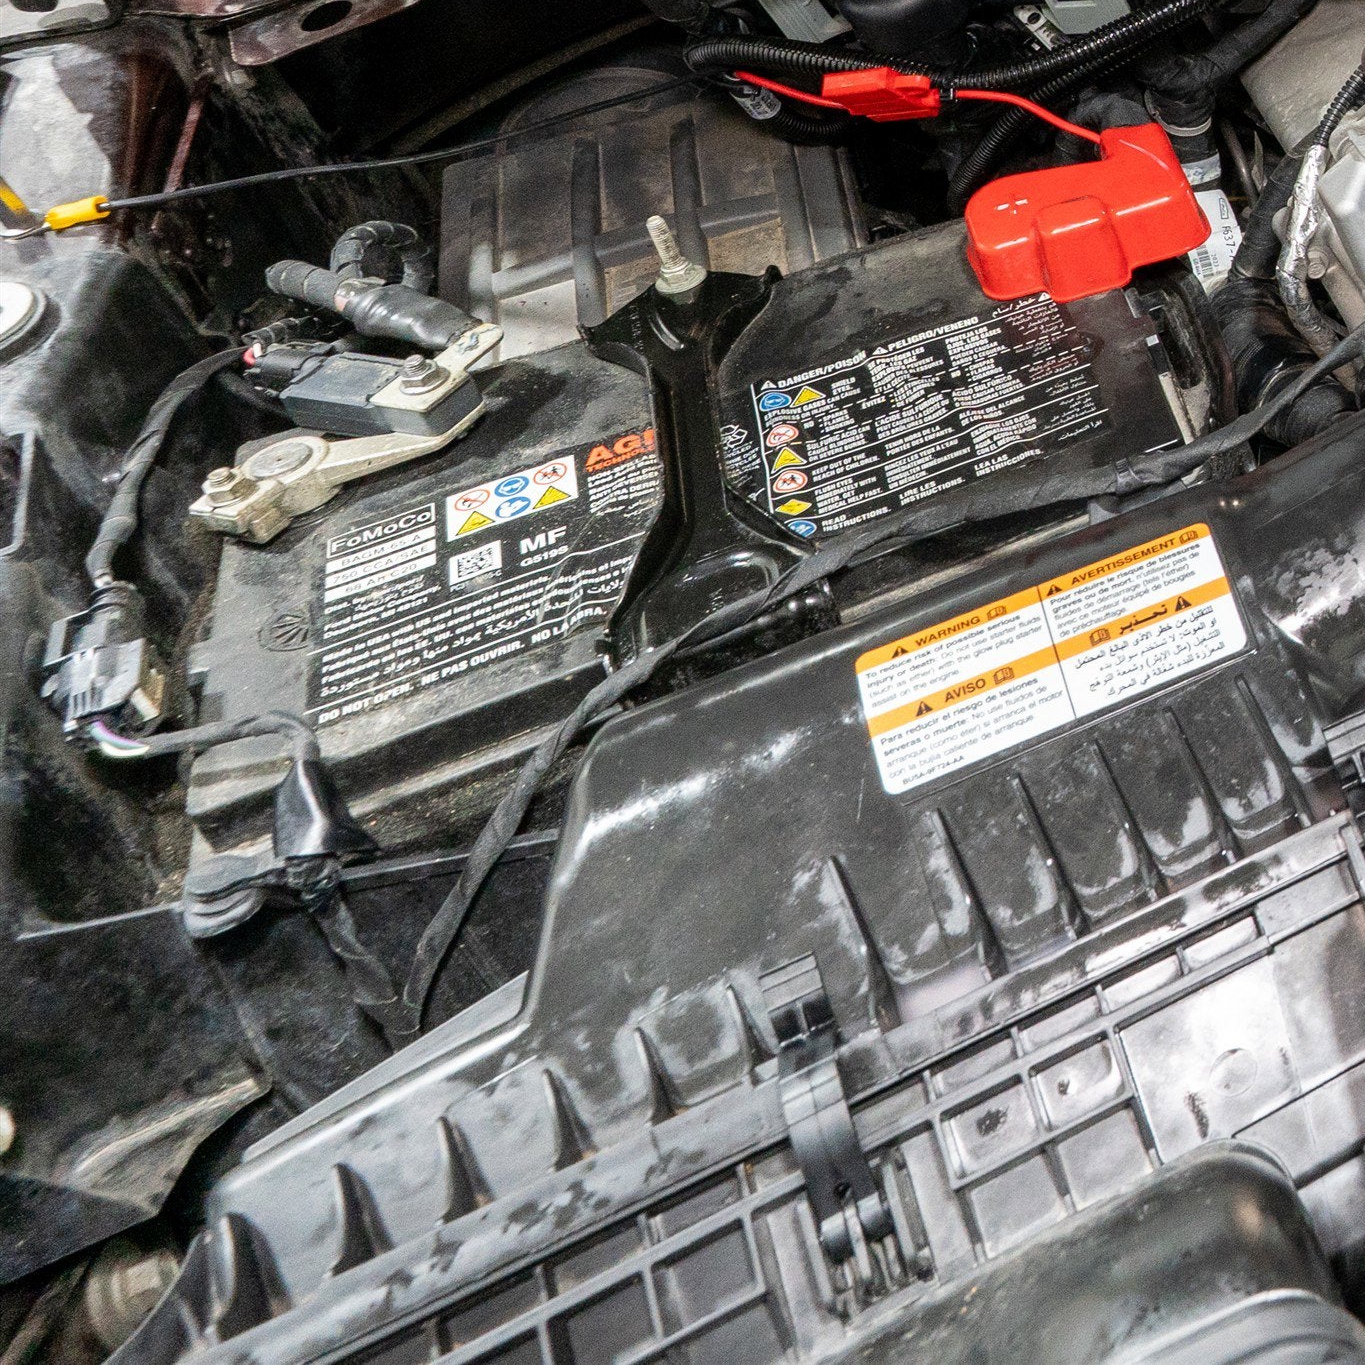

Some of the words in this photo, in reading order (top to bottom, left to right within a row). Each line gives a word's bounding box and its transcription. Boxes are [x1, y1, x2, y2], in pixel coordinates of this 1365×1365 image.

[887, 314, 980, 352] PELIGRO/VENENO
[777, 350, 868, 389] DANGER/POISON
[974, 459, 991, 471] LEA
[991, 453, 1009, 464] LAS
[900, 475, 966, 506] INSTRUCTIONS.
[919, 479, 937, 492] LES
[331, 507, 432, 554] FoMoCo
[518, 523, 567, 557] MF
[1069, 537, 1177, 585] AVERTISSEMENT
[1105, 575, 1115, 584] le
[1115, 563, 1144, 580] risque
[1145, 558, 1158, 569] de
[1157, 541, 1201, 564] blessures
[1097, 585, 1110, 596] de
[878, 655, 912, 674] reduce
[912, 648, 931, 661] risk
[933, 643, 944, 653] of
[945, 627, 984, 648] possible
[986, 613, 1021, 632] serious
[914, 615, 981, 647] WARNING
[941, 711, 951, 722] el
[984, 692, 997, 704] de
[998, 676, 1039, 698] lesiones
[942, 676, 987, 703] AVISO
